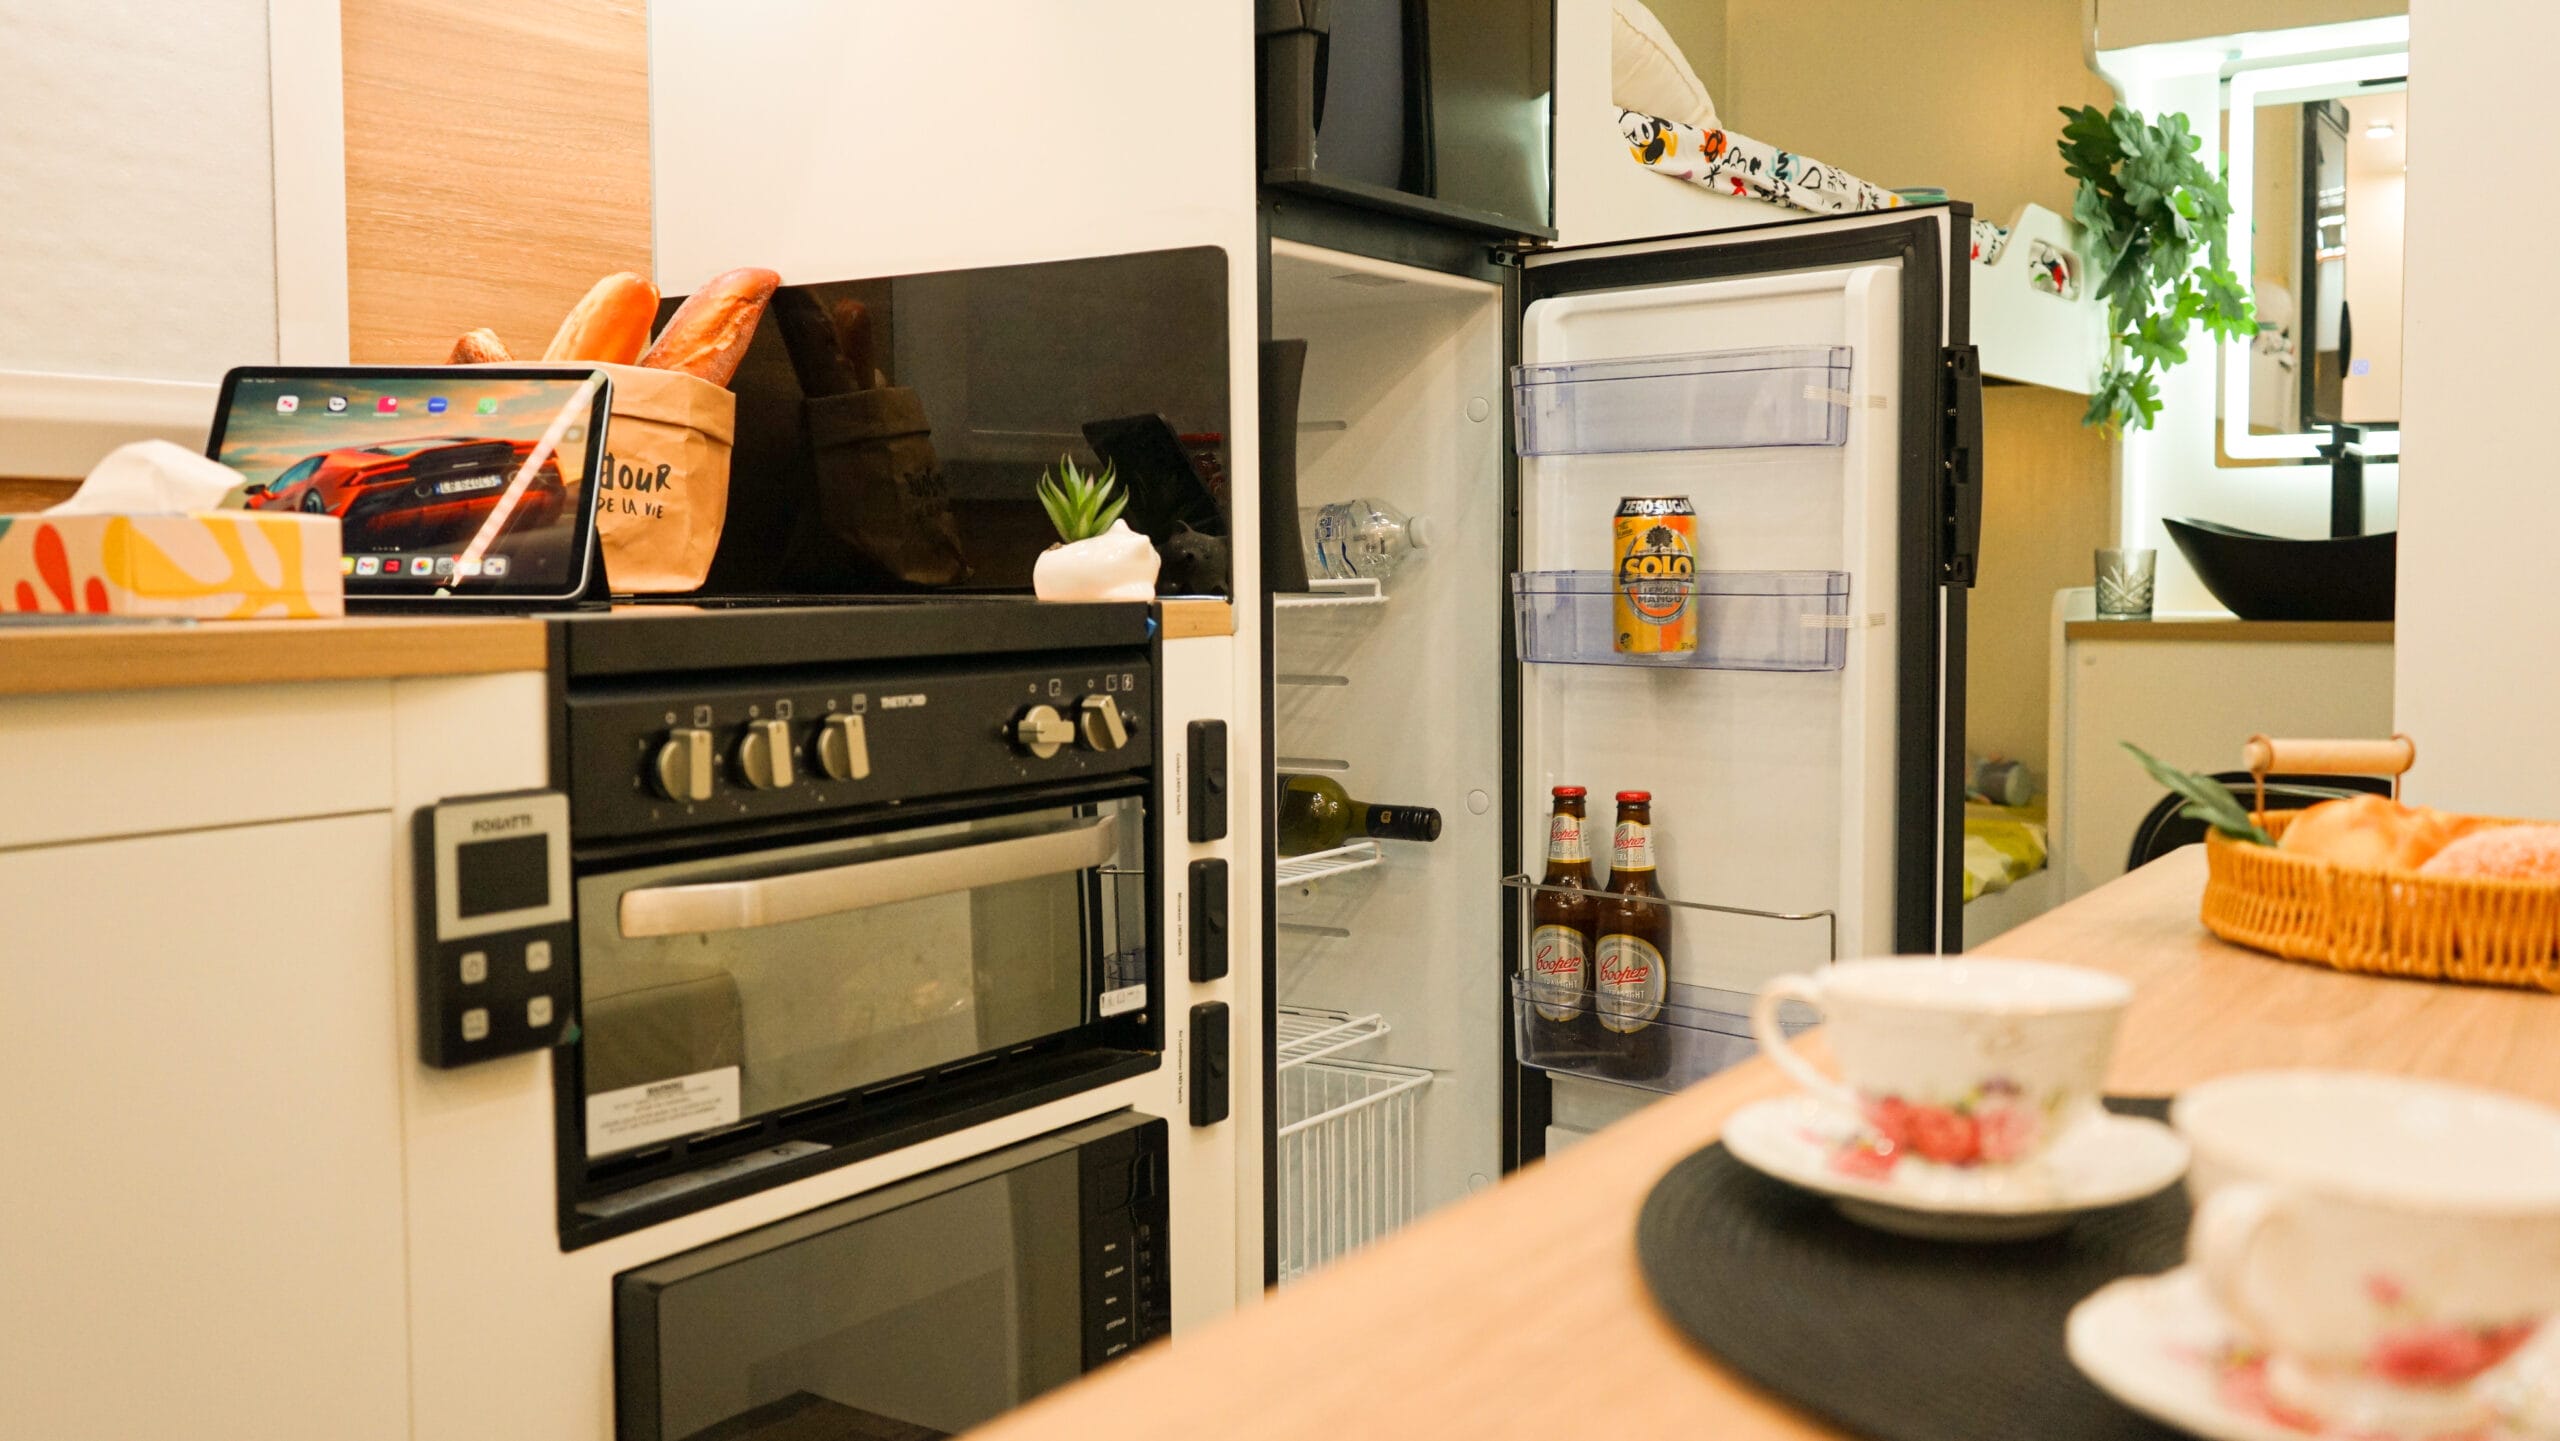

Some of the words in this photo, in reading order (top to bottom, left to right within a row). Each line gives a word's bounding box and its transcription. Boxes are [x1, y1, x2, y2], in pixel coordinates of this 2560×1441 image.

[622, 498, 638, 516] LA
[645, 502, 664, 519] VIE
[1621, 499, 1653, 514] ZERO
[1625, 555, 1692, 581] SOLO
[1637, 594, 1682, 604] MANGO
[1642, 585, 1680, 595] LEMON
[1551, 821, 1580, 842] Coopers
[1615, 829, 1646, 849] Coopers
[1536, 945, 1582, 975] Coopers
[1600, 955, 1649, 986] Coopers
